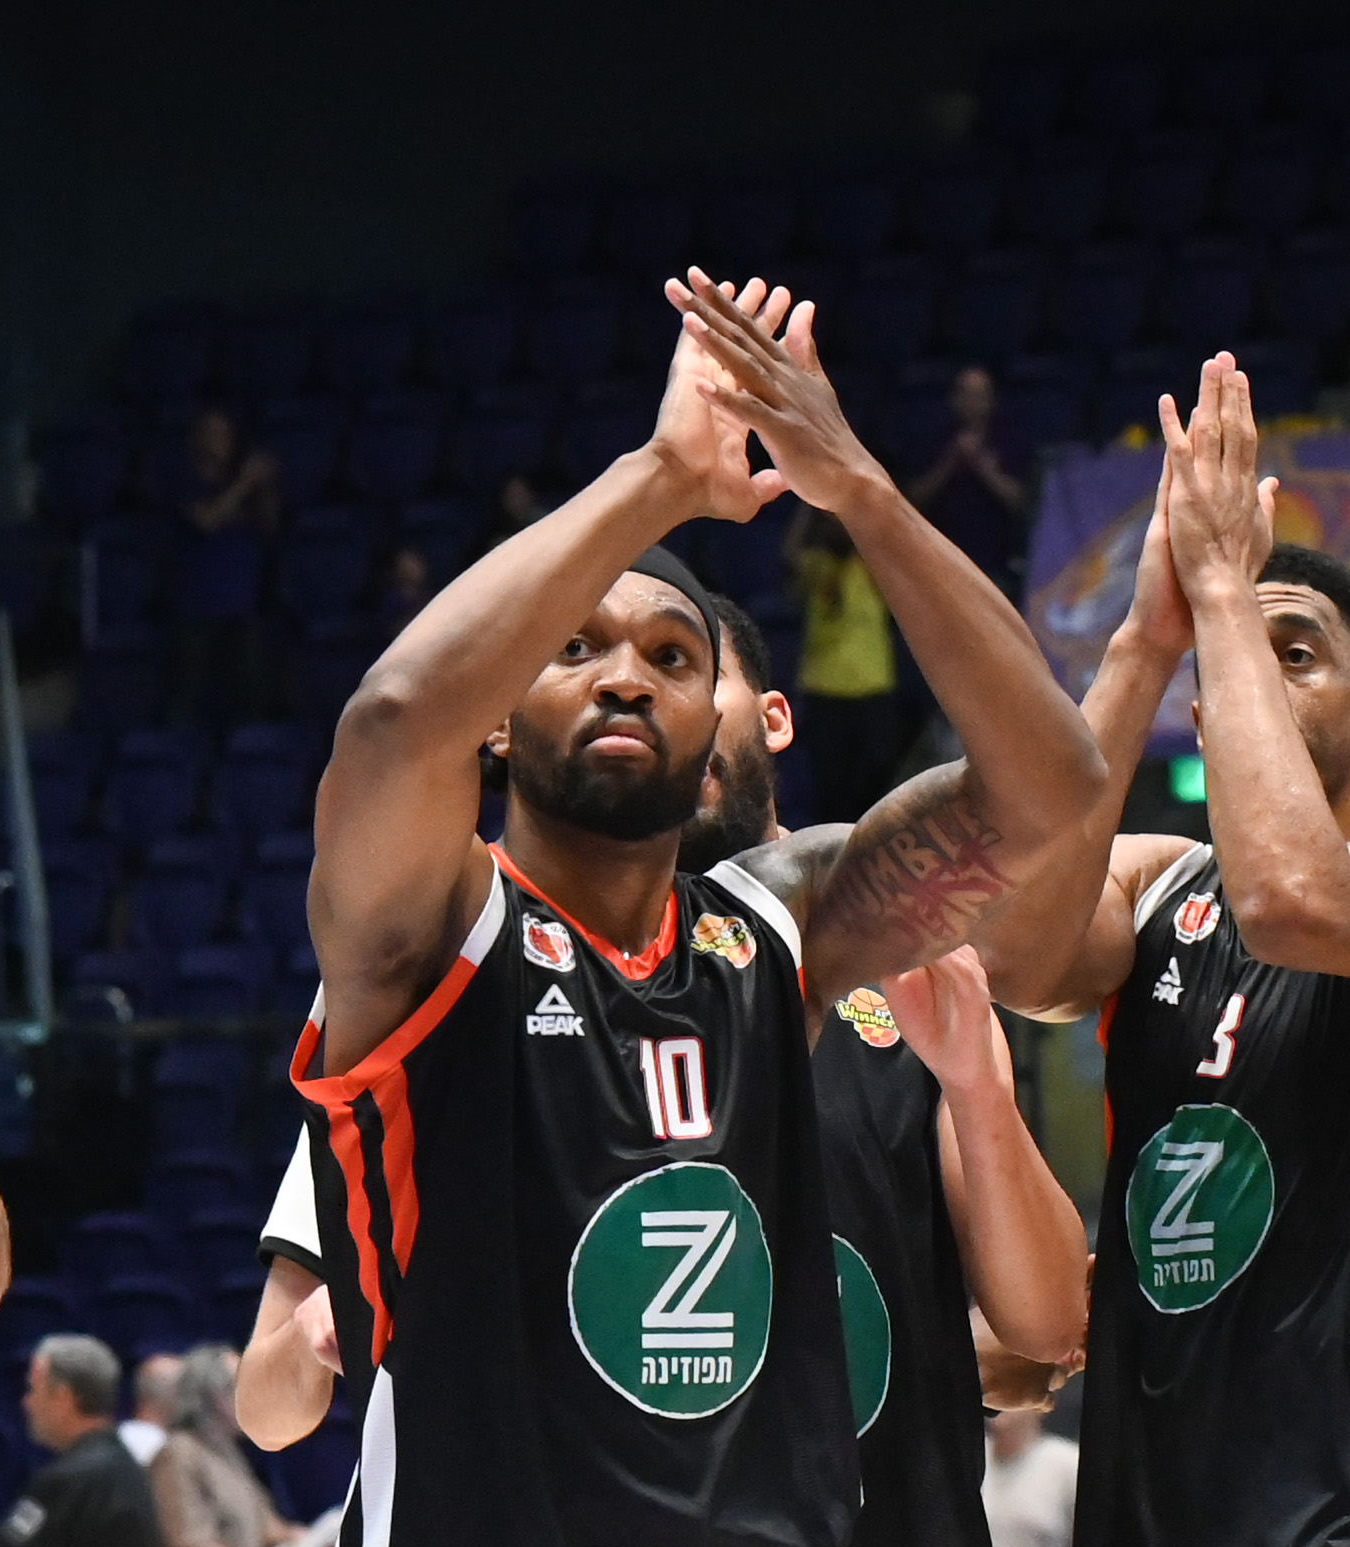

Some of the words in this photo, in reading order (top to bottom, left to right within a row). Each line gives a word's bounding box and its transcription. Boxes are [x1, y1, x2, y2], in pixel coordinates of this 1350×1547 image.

[526, 1015, 585, 1037] PEAK
[639, 1036, 712, 1139] 10
[640, 1355, 733, 1385] תפוזינה
